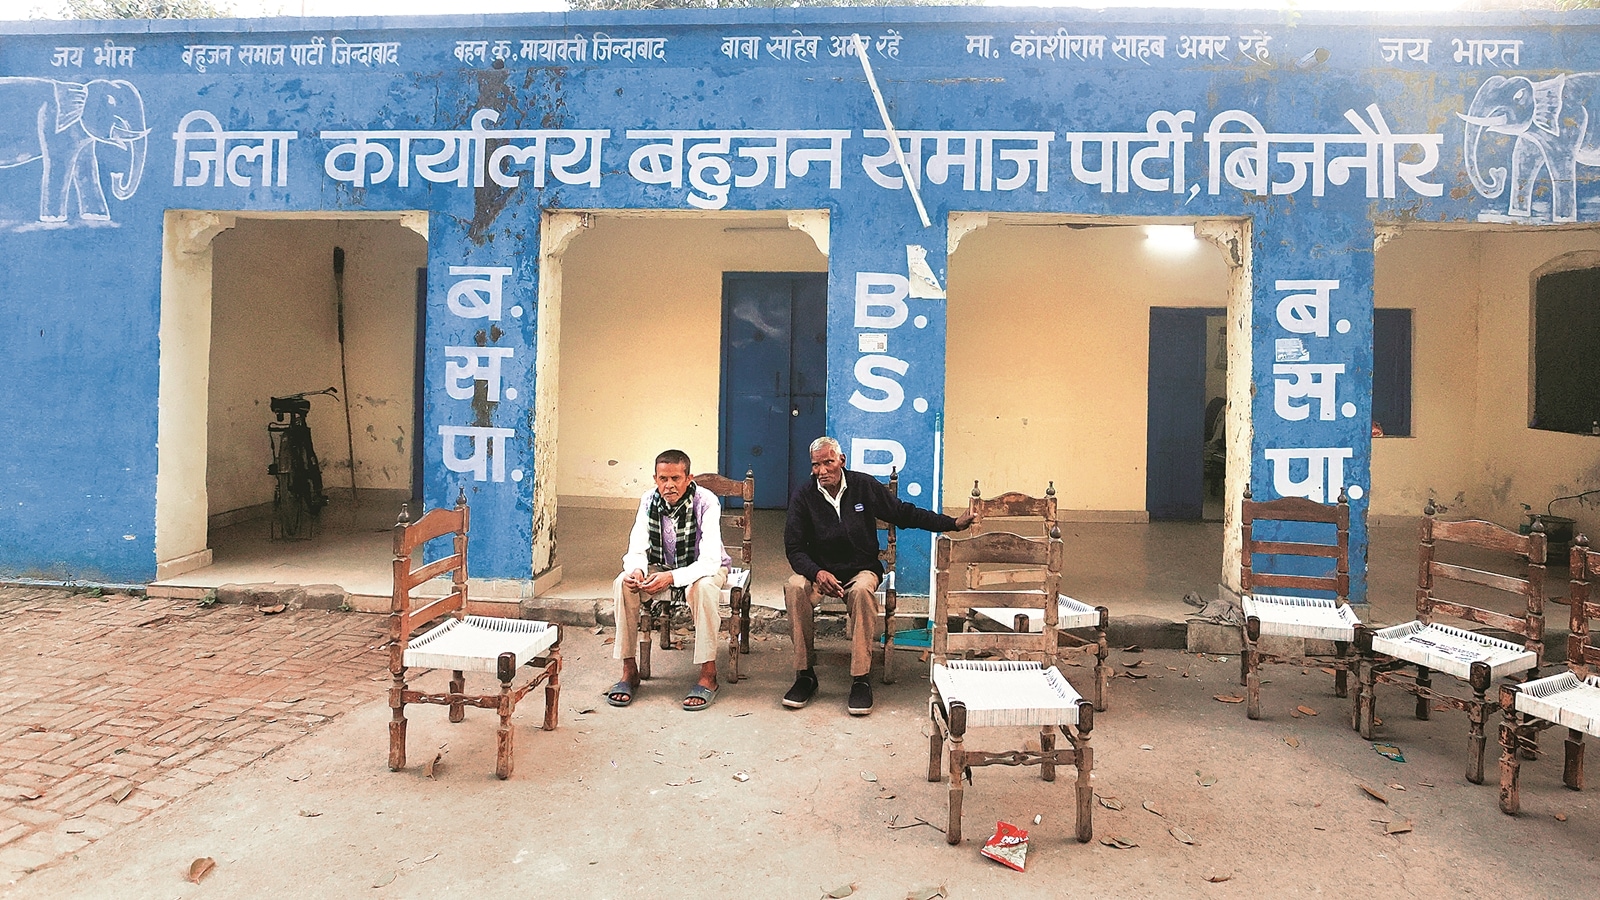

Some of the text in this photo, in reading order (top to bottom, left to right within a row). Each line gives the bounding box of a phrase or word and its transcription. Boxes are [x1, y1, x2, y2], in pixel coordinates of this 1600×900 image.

[50, 38, 137, 68] जय भीम
[181, 36, 401, 73] बहुजन समाज पार्टी जिन्दाबाद
[453, 40, 489, 66] बहन
[520, 33, 588, 63] मायावती
[592, 32, 668, 63] जिन्दाबाद
[720, 36, 762, 60] बाबा
[766, 29, 823, 63] साहेब
[875, 29, 904, 62] रहें
[965, 27, 1273, 66] मा. कांशीराम साहब अमर रहें
[1378, 38, 1524, 68] जय भारत
[172, 109, 298, 187] जिला
[320, 108, 610, 188] कार्यालय
[626, 129, 852, 210] बहुजन
[861, 129, 1055, 192] समाज
[1203, 103, 1443, 198] बिजनौर
[853, 272, 928, 329] B.
[438, 266, 523, 483] ब. स. पा.
[848, 354, 929, 413] S.
[1264, 280, 1364, 504] ब. स. पा.
